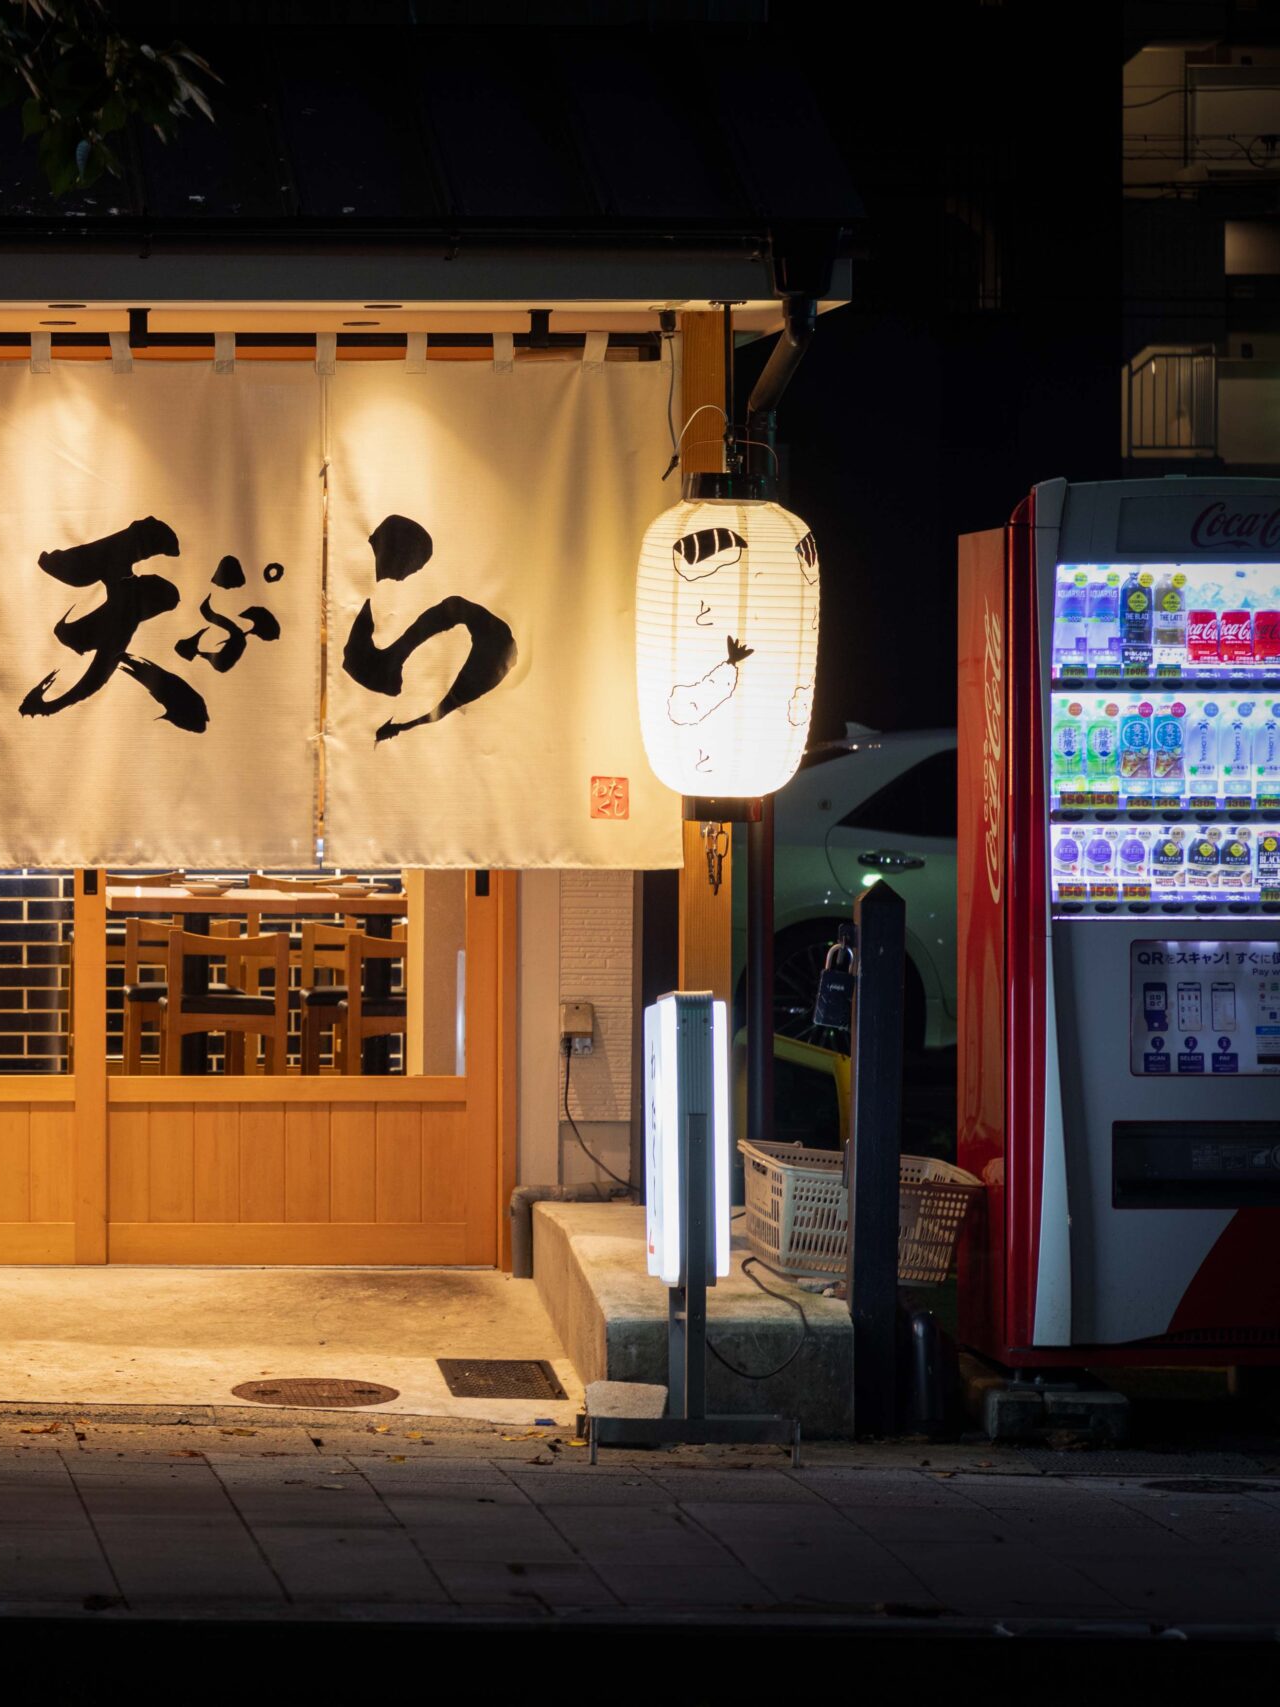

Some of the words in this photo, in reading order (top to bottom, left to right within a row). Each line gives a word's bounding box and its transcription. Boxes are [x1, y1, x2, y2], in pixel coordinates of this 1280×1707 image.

[19, 515, 518, 750] 天ぷら
[696, 600, 713, 626] と
[984, 594, 1001, 904] Coca-Cola
[1252, 968, 1269, 977] Pay
